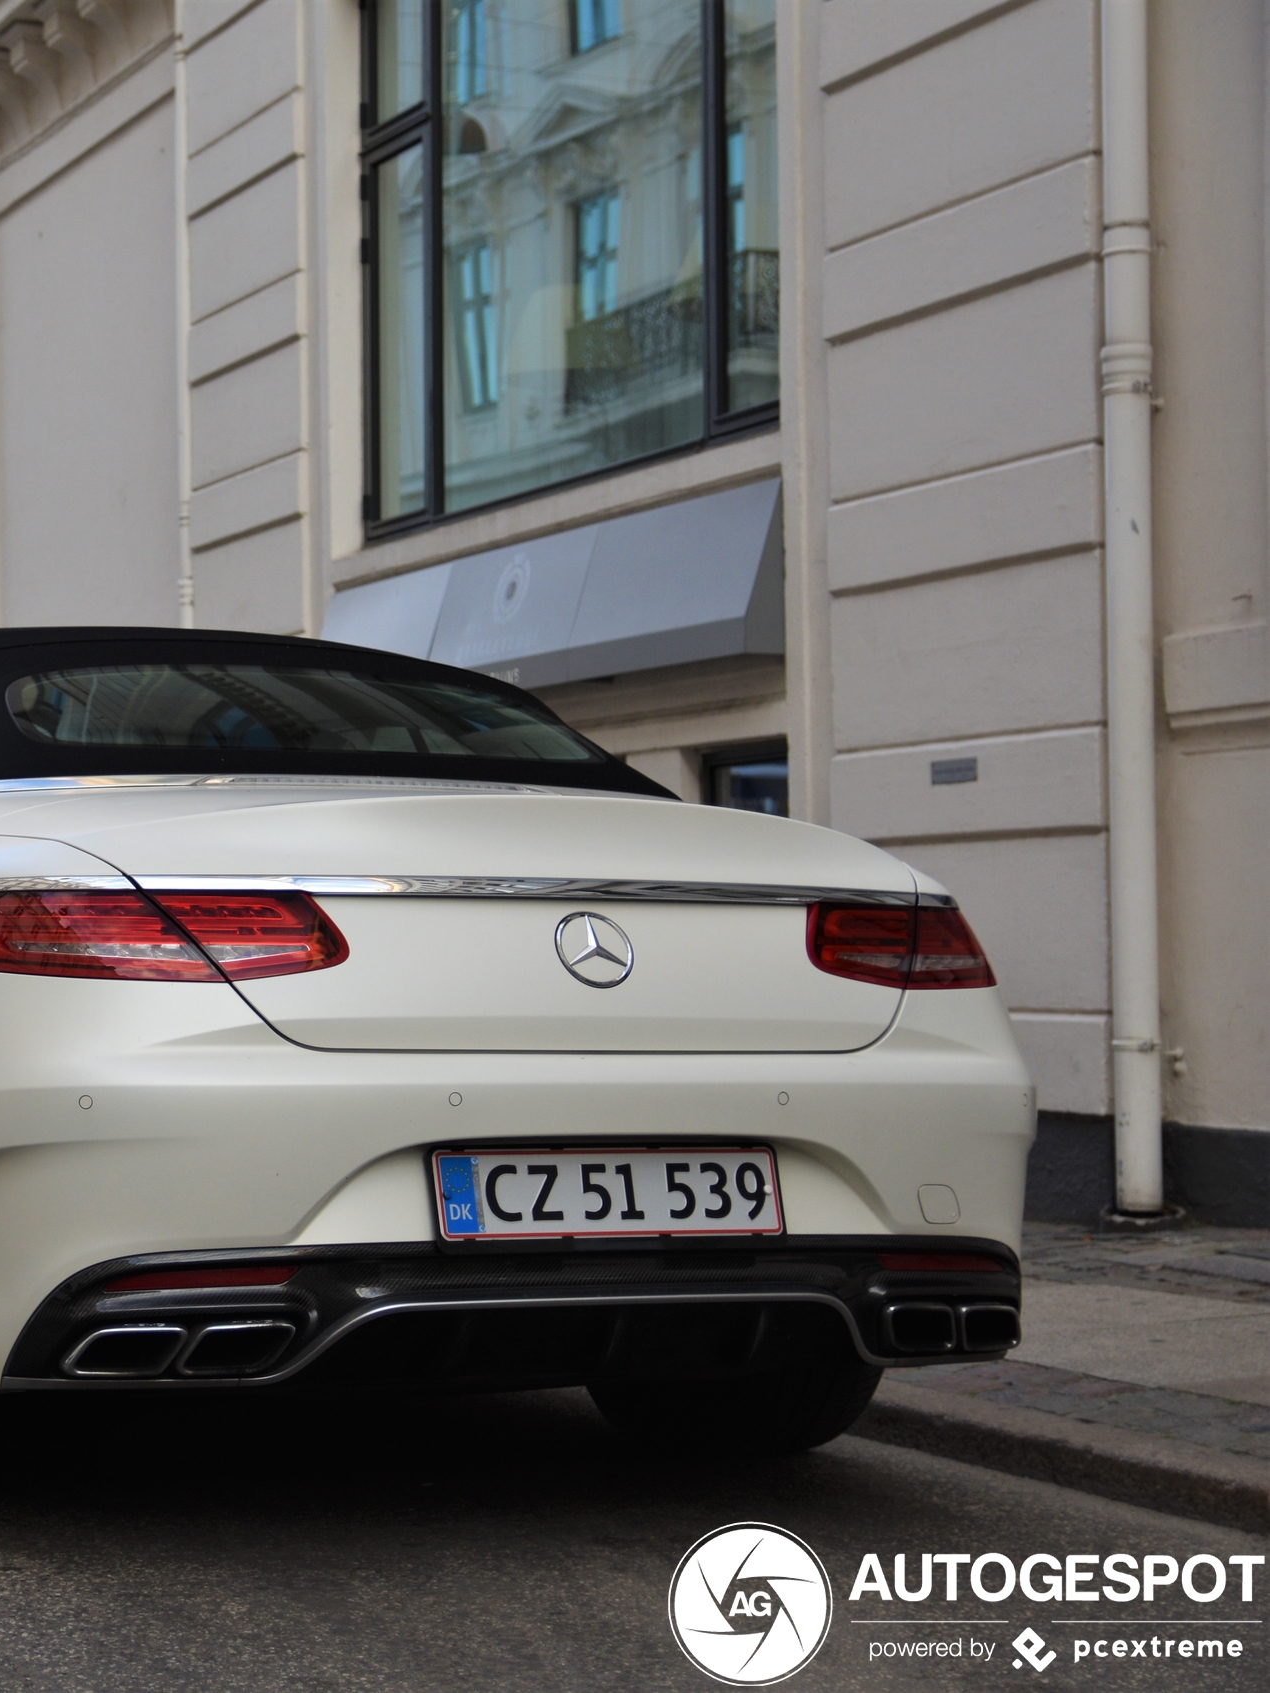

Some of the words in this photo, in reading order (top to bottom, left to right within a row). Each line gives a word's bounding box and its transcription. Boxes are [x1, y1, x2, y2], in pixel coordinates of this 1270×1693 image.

[485, 1163, 564, 1222] CZ
[580, 1162, 645, 1221] 51
[665, 1161, 767, 1221] 539
[449, 1203, 473, 1221] DK
